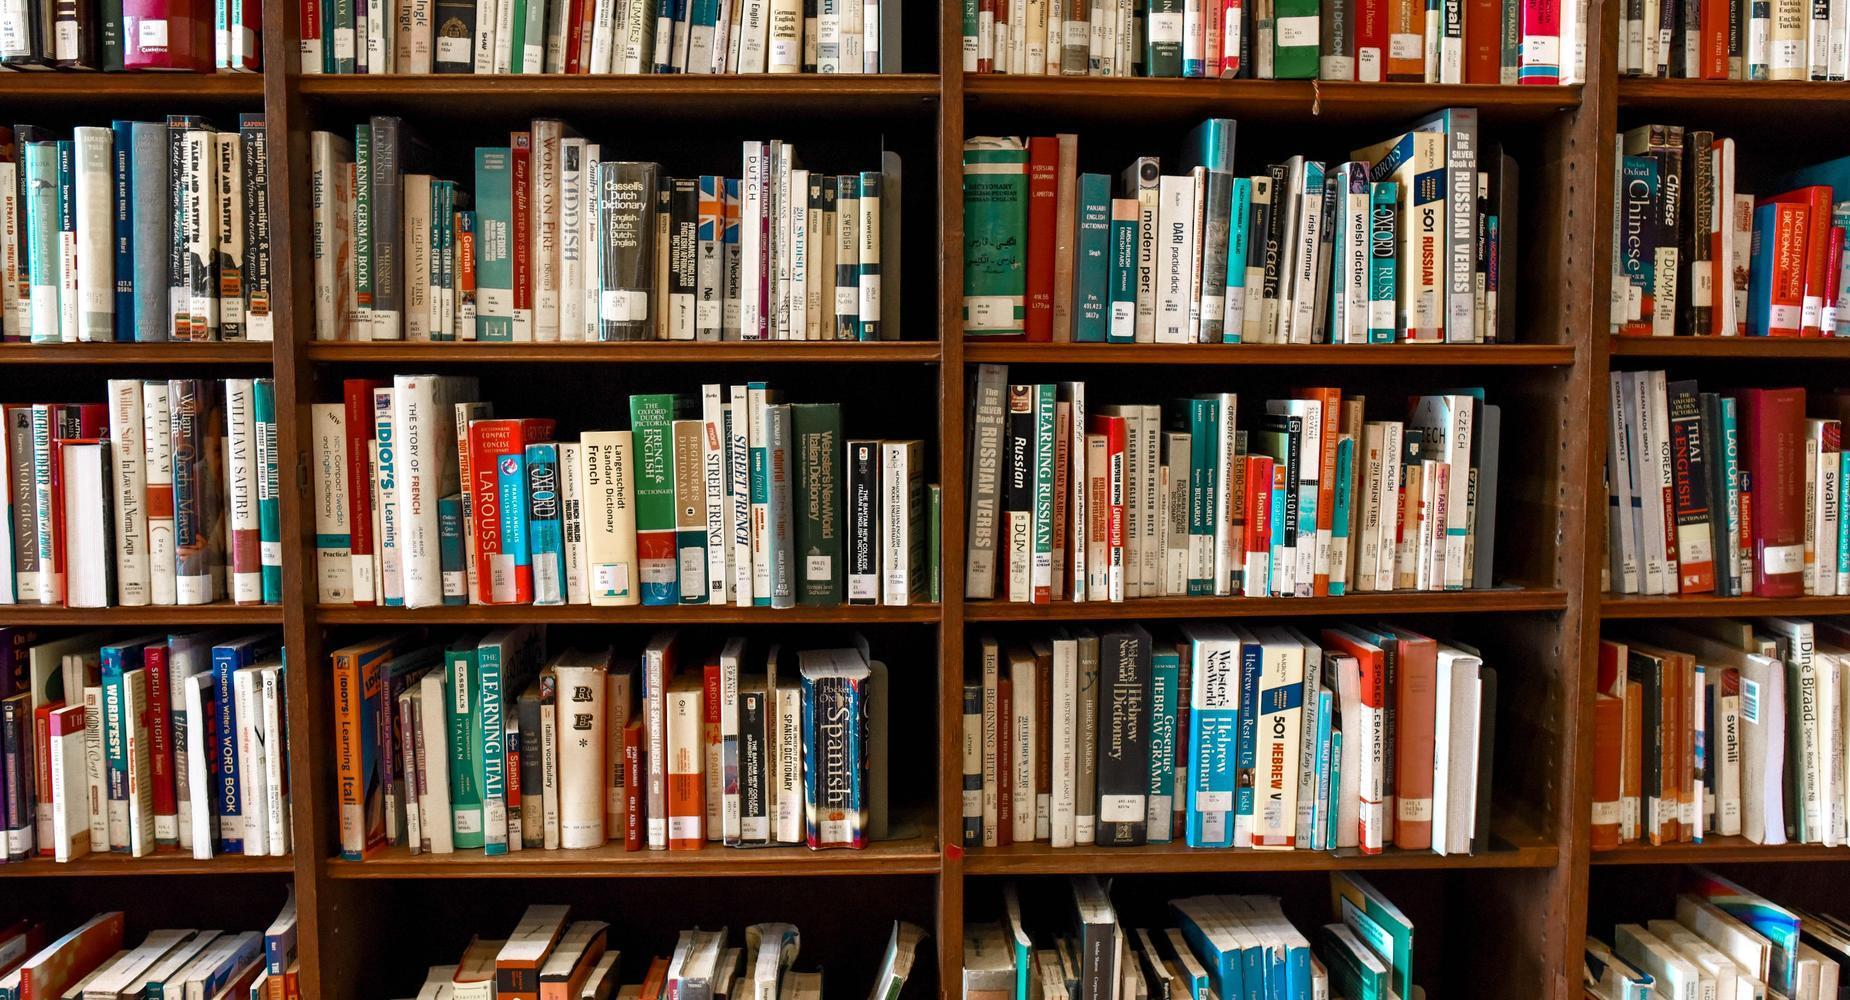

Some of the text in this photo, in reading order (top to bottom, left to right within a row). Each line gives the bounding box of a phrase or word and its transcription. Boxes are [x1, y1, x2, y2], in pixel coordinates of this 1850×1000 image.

[750, 3, 761, 29] English
[1365, 10, 1374, 38] Dictionary
[247, 142, 256, 245] Reader American
[313, 170, 323, 259] Yiddish English
[358, 144, 368, 287] LEARNING GERMAN BOOK
[543, 136, 555, 252] WORDS ON FIRE
[564, 174, 578, 260] YIDDISH
[602, 201, 646, 211] Dictionary
[611, 192, 636, 200] Dutch
[1665, 175, 1678, 226] Chinese
[497, 222, 505, 258] SWEDISH
[843, 214, 851, 250] SWEDISH
[1143, 210, 1154, 262] modern
[1171, 223, 1183, 274] DARI practical
[1304, 215, 1316, 281] irish grammar
[1356, 214, 1364, 246] welsh
[1373, 209, 1393, 256] OXFORD
[1423, 209, 1434, 285] 501 RUSSIAN
[1454, 172, 1470, 292] RUSSIAN VERBS
[1627, 179, 1649, 270] Chinese
[1782, 211, 1791, 269] DICTIONARY
[260, 253, 269, 276] slam
[463, 235, 471, 272] German
[1264, 240, 1279, 298] gaelic
[120, 388, 132, 423] William
[182, 394, 194, 437] William
[1458, 410, 1467, 449] CZECH
[34, 410, 49, 484] RICHARD LEDERER
[159, 396, 169, 473] WILLIAM
[232, 392, 248, 520] WILLIAM SAFIRE
[409, 403, 420, 514] THE STORY OF FRENCH
[644, 429, 654, 477] ENGLISH
[654, 429, 663, 473] FRENCH
[1688, 422, 1701, 462] THAI
[1728, 430, 1736, 456] LAO
[378, 422, 395, 547] IDIOT'S Learning
[460, 455, 470, 483] PITFALLS
[588, 445, 599, 485] French
[615, 445, 625, 509] Langenscheidt
[680, 436, 688, 502] DICTIONARY
[690, 436, 699, 501] BEGINNER'S
[708, 454, 720, 499] STREET
[808, 433, 821, 520] Italian Dictionary
[975, 427, 997, 547] RUSSIAN VERBS
[1014, 437, 1026, 488] Russian
[1038, 404, 1052, 543] LEARNING RUSSIAN
[1662, 442, 1670, 484] KOREAN
[1676, 437, 1690, 506] ENGLISH
[124, 490, 136, 505] with
[324, 480, 332, 518] Dictionary
[463, 493, 472, 517] FRENCH
[532, 468, 555, 516] OXFORD
[604, 445, 614, 533] Standard Dictionary
[734, 434, 748, 546] STREET FRENCH
[1257, 492, 1266, 531] Bosnian
[1286, 494, 1295, 530] SLOVENE
[1825, 472, 1836, 521] swahili
[21, 503, 34, 570] GIGANTIS
[480, 471, 496, 560] LAROUSSE
[221, 662, 230, 702] Children's
[1128, 639, 1138, 681] Webster's
[1218, 650, 1231, 707] Webster's
[1800, 642, 1814, 673] Diné
[152, 667, 163, 750] SPELL RIGHT
[709, 676, 718, 720] LAROUSSE
[986, 654, 994, 748] Held BEGINNING
[1153, 676, 1164, 735] HEBREW
[1243, 654, 1255, 738] Hebrew Rest
[1306, 665, 1316, 706] Prayerbook
[1802, 678, 1814, 726] Bizaad:
[107, 684, 120, 759] WORDFEST!
[340, 677, 351, 770] IDIOT'S Learning
[482, 672, 500, 753] LEARNING
[545, 724, 553, 746] italian
[1108, 690, 1126, 760] Dictionary
[1128, 690, 1141, 742] Hebrew
[1306, 708, 1314, 736] Hebrew
[223, 737, 233, 773] WORD
[784, 714, 792, 791] SPANISH DICTIONARY
[821, 707, 850, 802] Spanish
[1085, 742, 1093, 774] AMERICA
[1216, 717, 1232, 772] Hebrew
[1271, 716, 1284, 789] 501 HEBREW
[1727, 715, 1736, 763] swahili
[226, 778, 235, 812] BOOK
[510, 755, 518, 790] Spanish
[1302, 771, 1311, 787] Way
[1241, 791, 1249, 810] Fields
